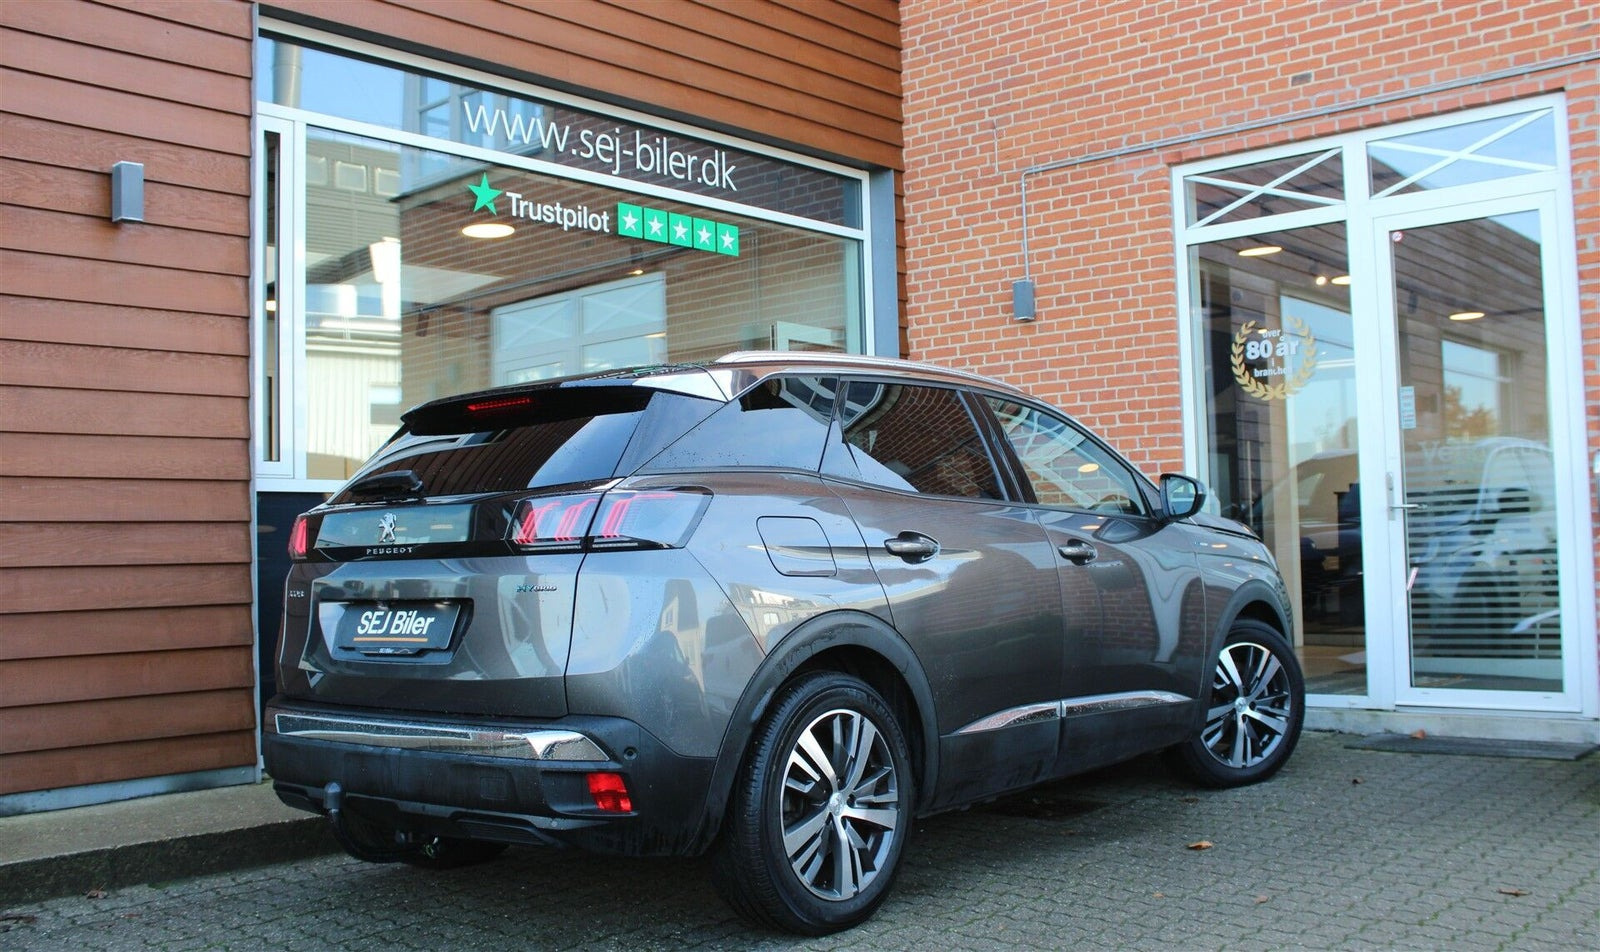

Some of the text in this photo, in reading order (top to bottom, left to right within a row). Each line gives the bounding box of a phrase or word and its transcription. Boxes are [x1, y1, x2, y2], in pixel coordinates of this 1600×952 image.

[464, 101, 738, 192] www.sej-biler.dk
[506, 191, 610, 233] Trustpilot
[1246, 336, 1299, 359] 80 år
[366, 546, 413, 555] PEUGEOT
[357, 610, 435, 635] SEJ Biler
